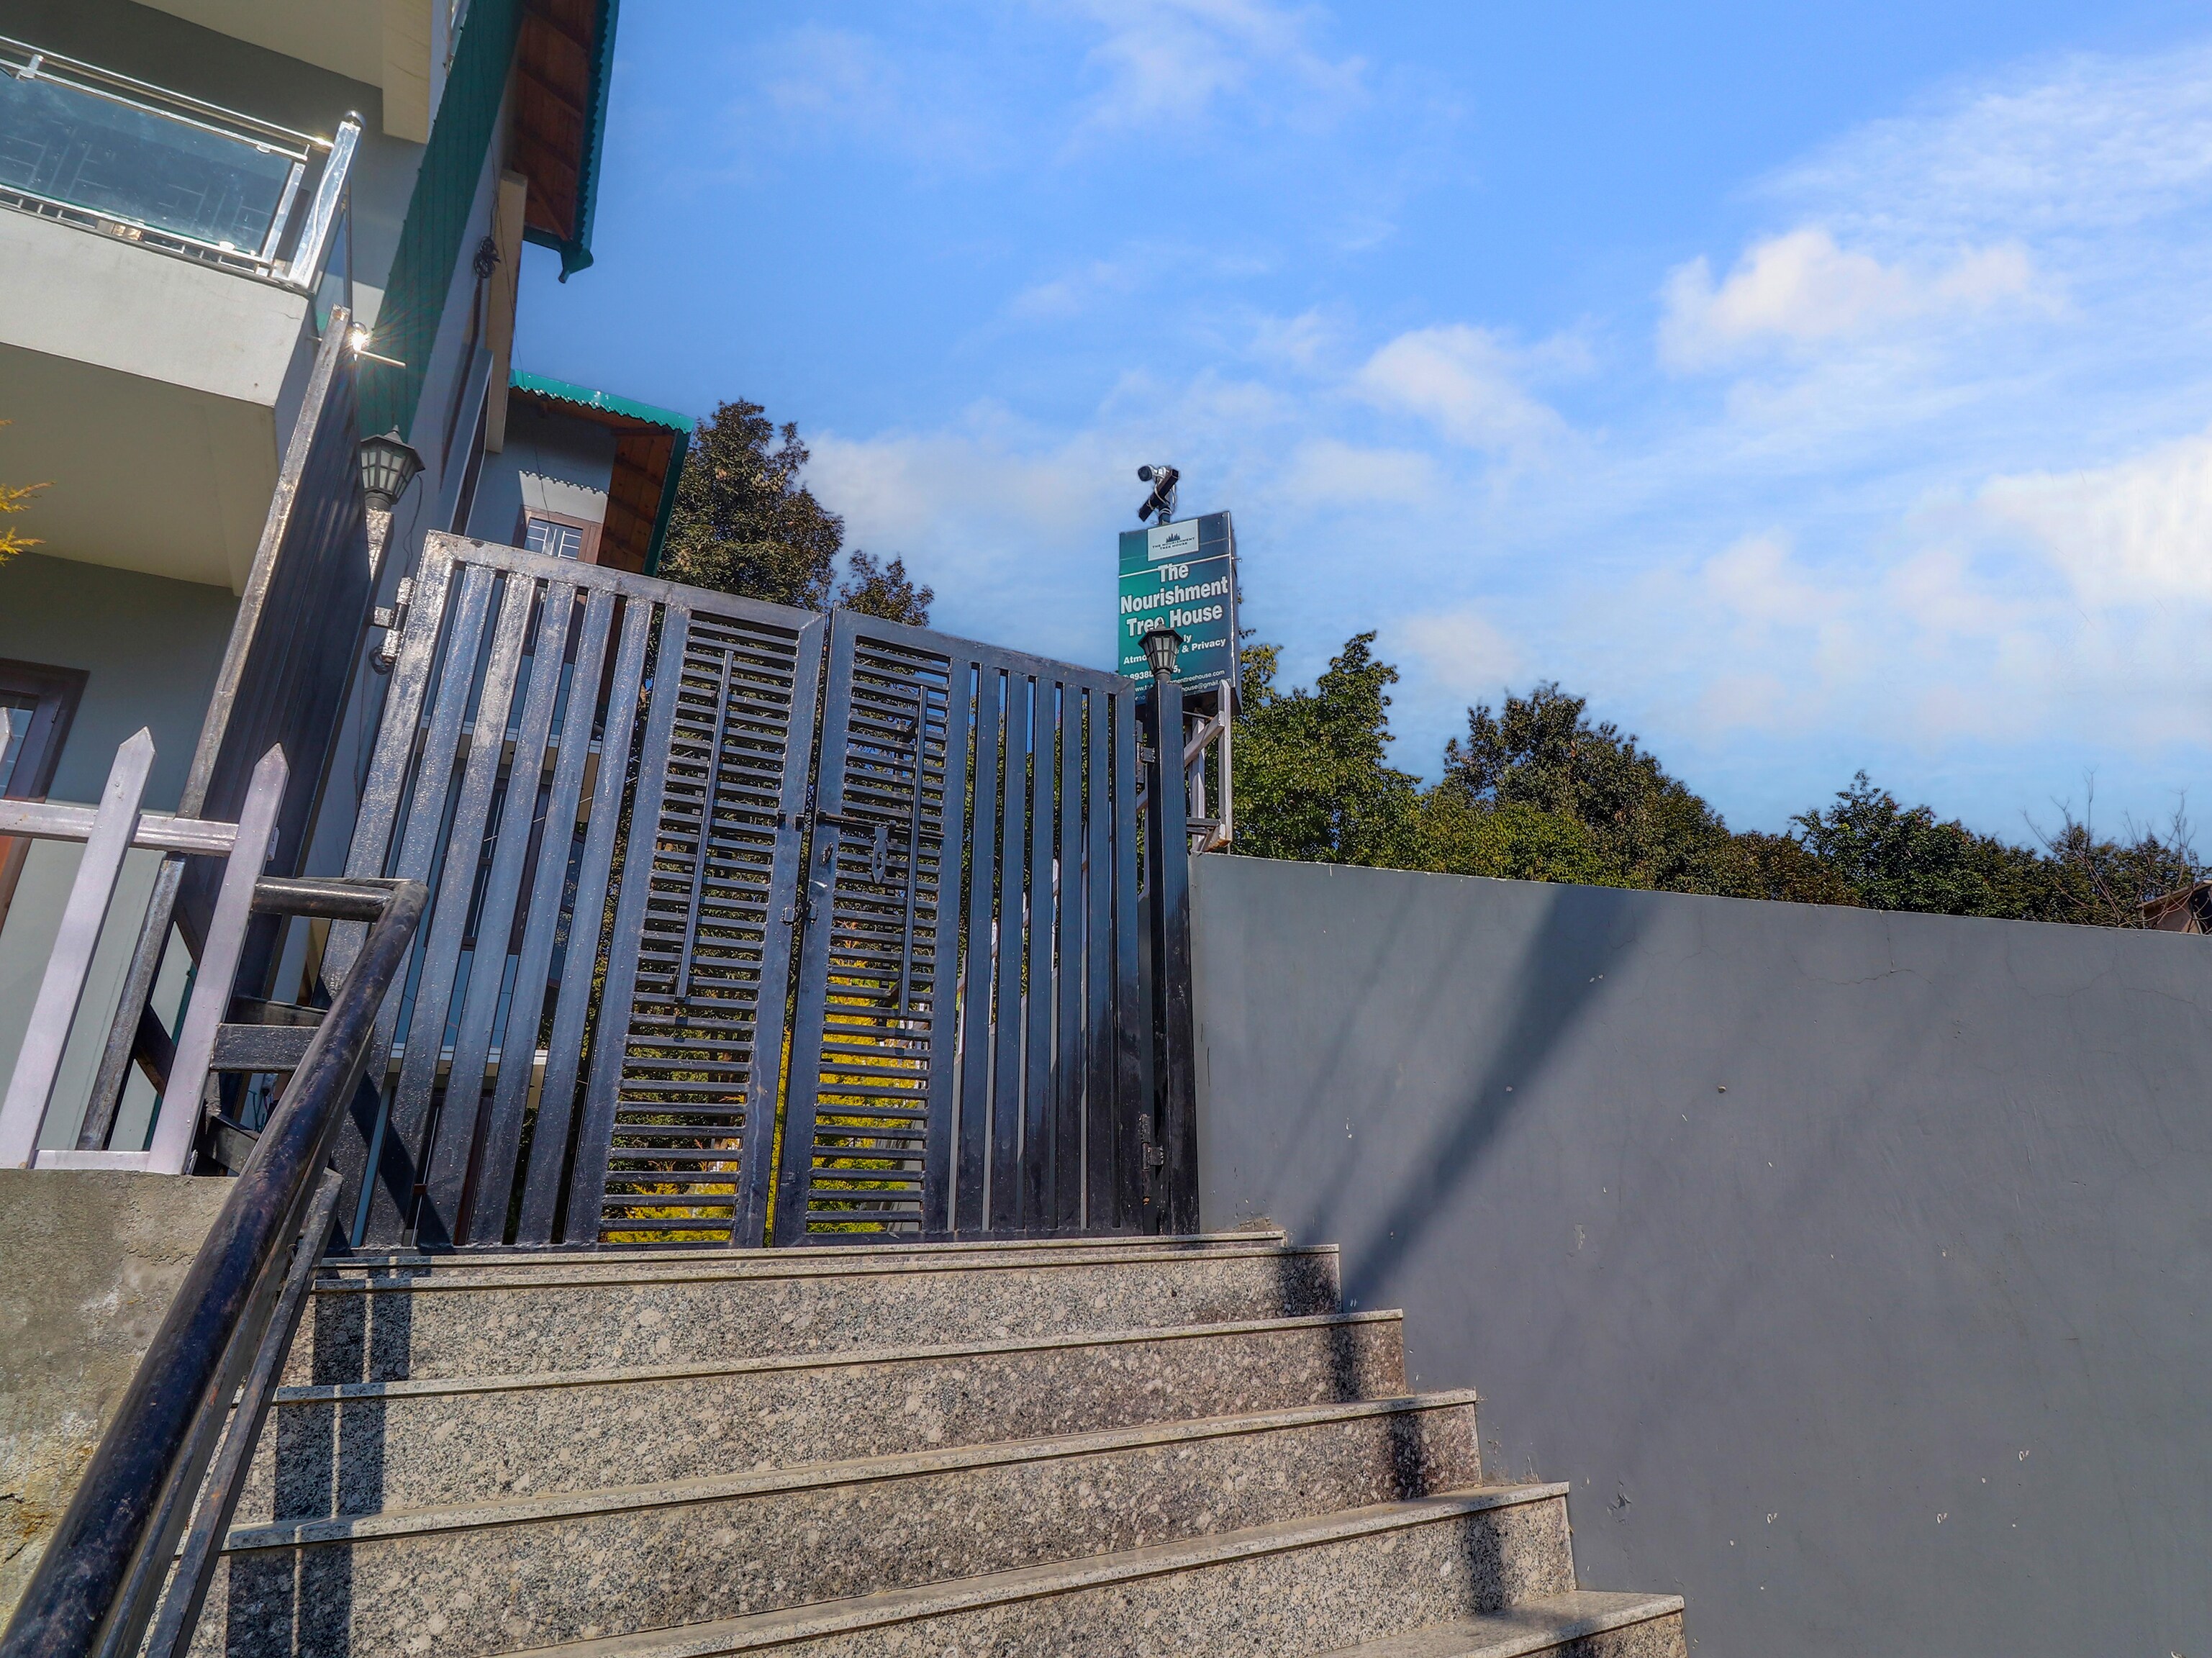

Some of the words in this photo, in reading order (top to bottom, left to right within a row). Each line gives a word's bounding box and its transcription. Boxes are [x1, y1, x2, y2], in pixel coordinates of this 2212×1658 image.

[1158, 563, 1188, 582] The
[1120, 576, 1228, 615] Nourishment
[1169, 604, 1223, 629] House
[1182, 645, 1189, 653] &
[1192, 638, 1226, 651] Privacy
